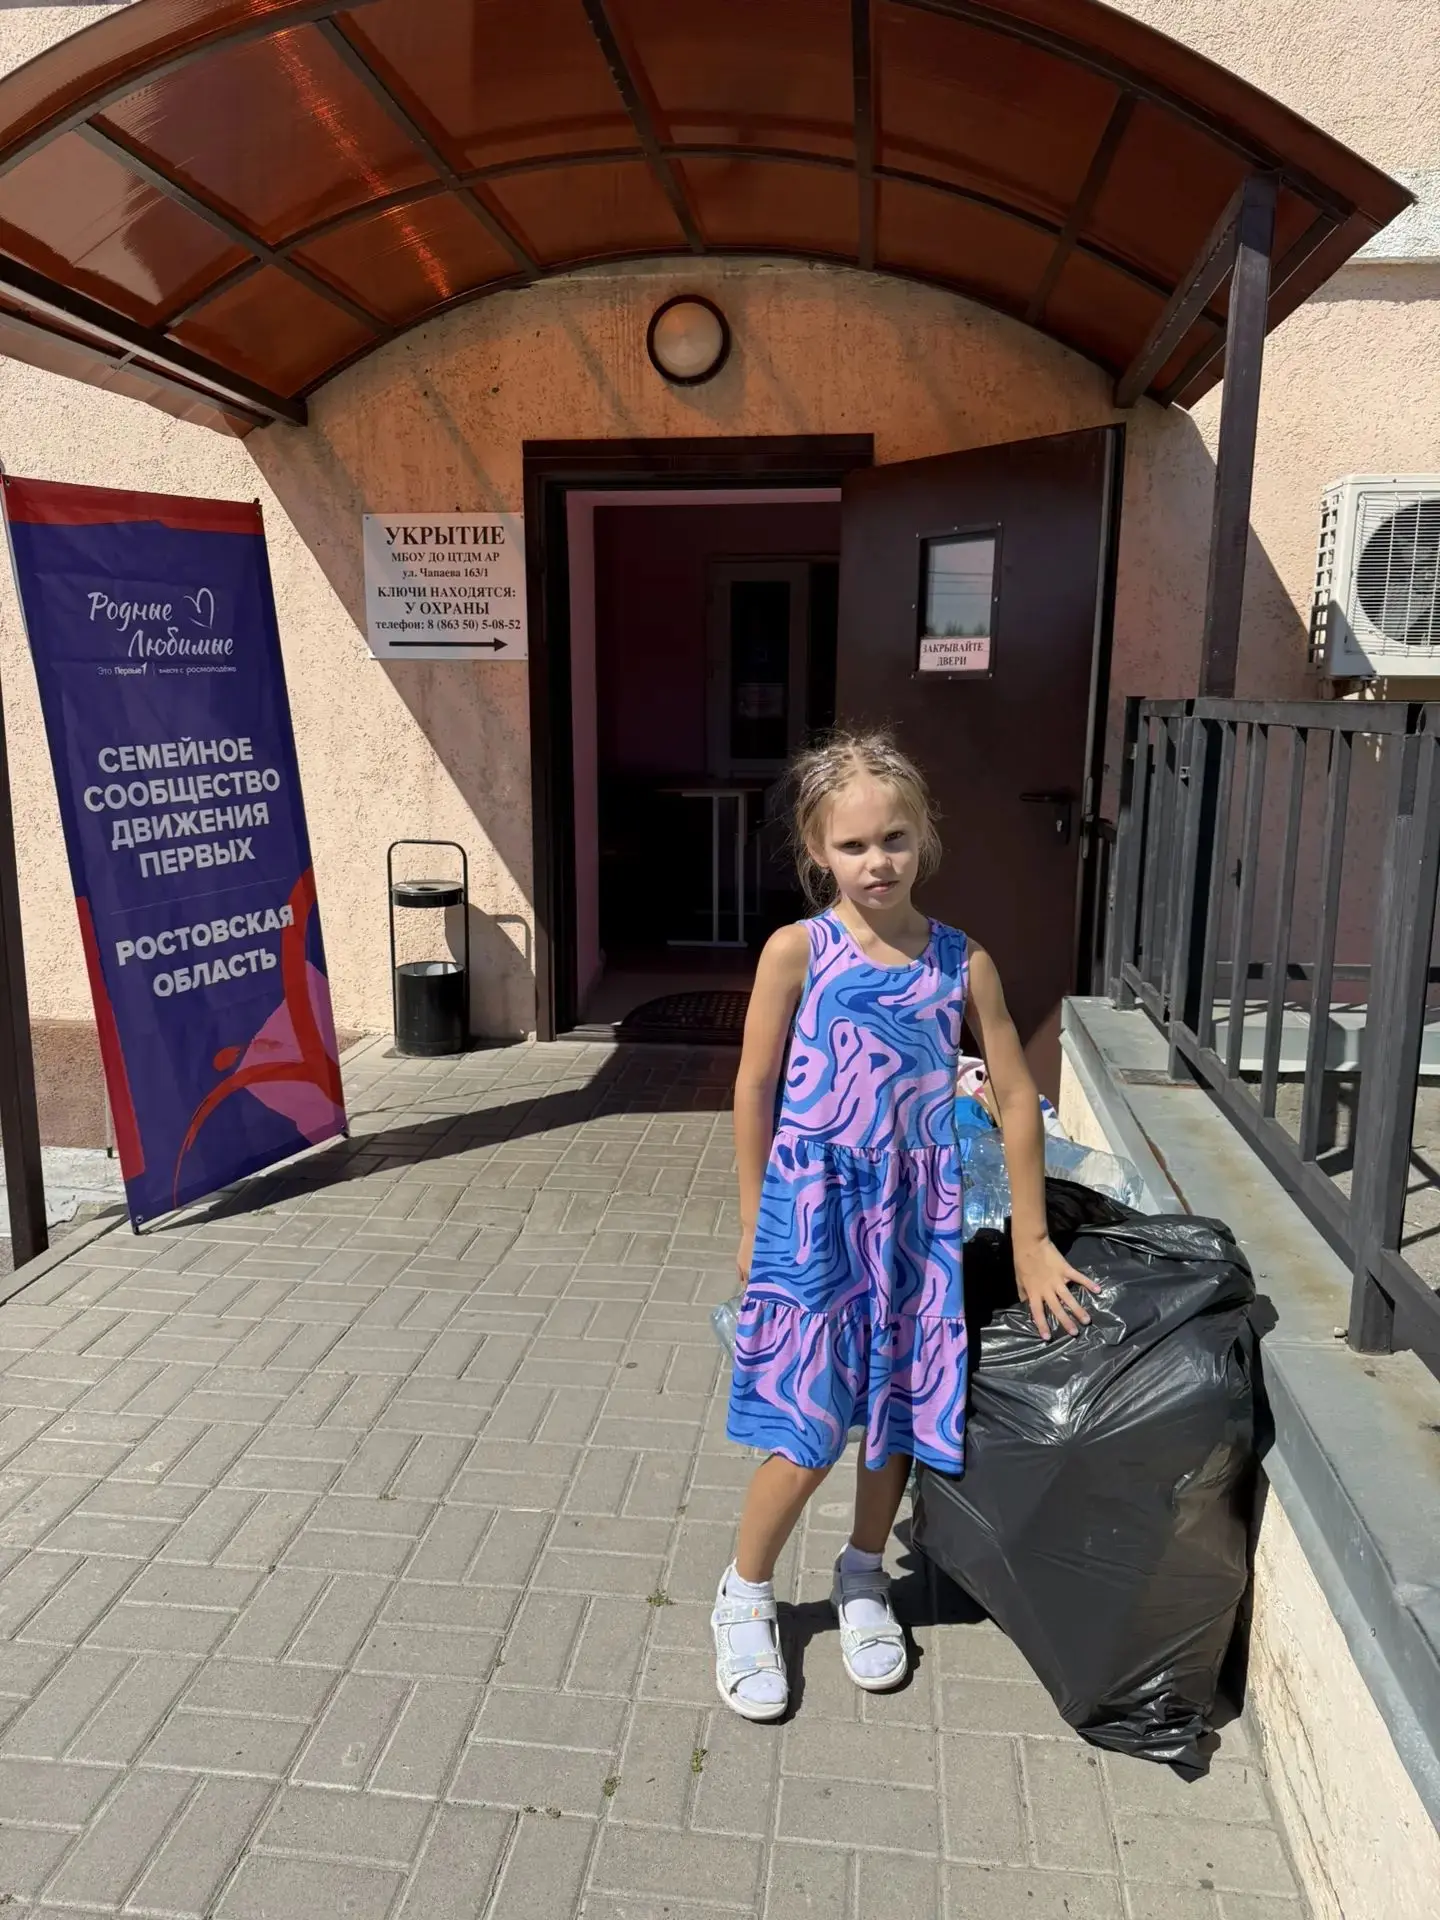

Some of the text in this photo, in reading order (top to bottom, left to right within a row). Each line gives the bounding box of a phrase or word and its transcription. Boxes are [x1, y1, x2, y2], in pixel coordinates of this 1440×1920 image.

[384, 525, 506, 546] УКРЫТИЕ
[391, 552, 500, 563] МБОУ ДО ЦТДМ АР
[402, 568, 489, 580] ул. Чапаева 163/1
[377, 587, 516, 599] КЛЮЧИ НАХОДЯТСЯ:
[87, 591, 173, 632] Родные
[404, 602, 490, 615] У ОХРАНЫ
[375, 620, 521, 632] телефон: 8 (863 50) 5-08-52
[128, 626, 234, 658] Любимые
[923, 641, 984, 653] ЗАКРЫВАЙТЕ
[937, 656, 967, 667] ДВЕРИ
[98, 736, 254, 773] СЕМЕЙНОЕ
[83, 768, 280, 812] СООБЩЕСТВО
[111, 802, 270, 851] ДВИЖЕНИЯ
[139, 837, 256, 878] ПЕРВЫХ
[115, 904, 295, 966] РОСТОВСКАЯ
[153, 948, 277, 997] ОБЛАСТЬ
